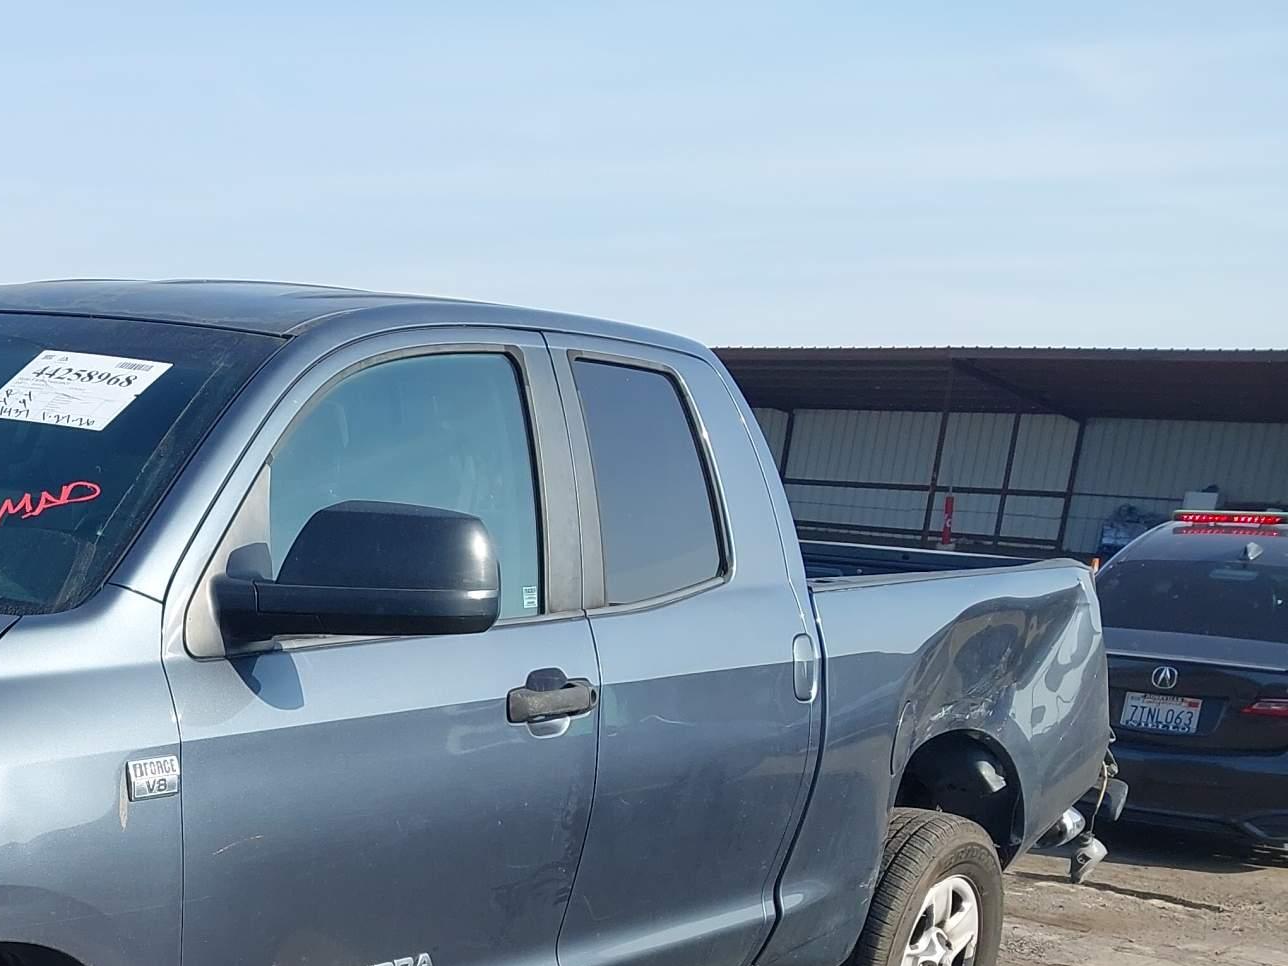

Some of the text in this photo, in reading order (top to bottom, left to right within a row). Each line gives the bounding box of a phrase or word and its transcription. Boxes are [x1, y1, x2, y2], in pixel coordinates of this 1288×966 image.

[32, 365, 138, 388] 44258968
[1129, 704, 1194, 727] 7TNL063
[145, 778, 168, 793] V8
